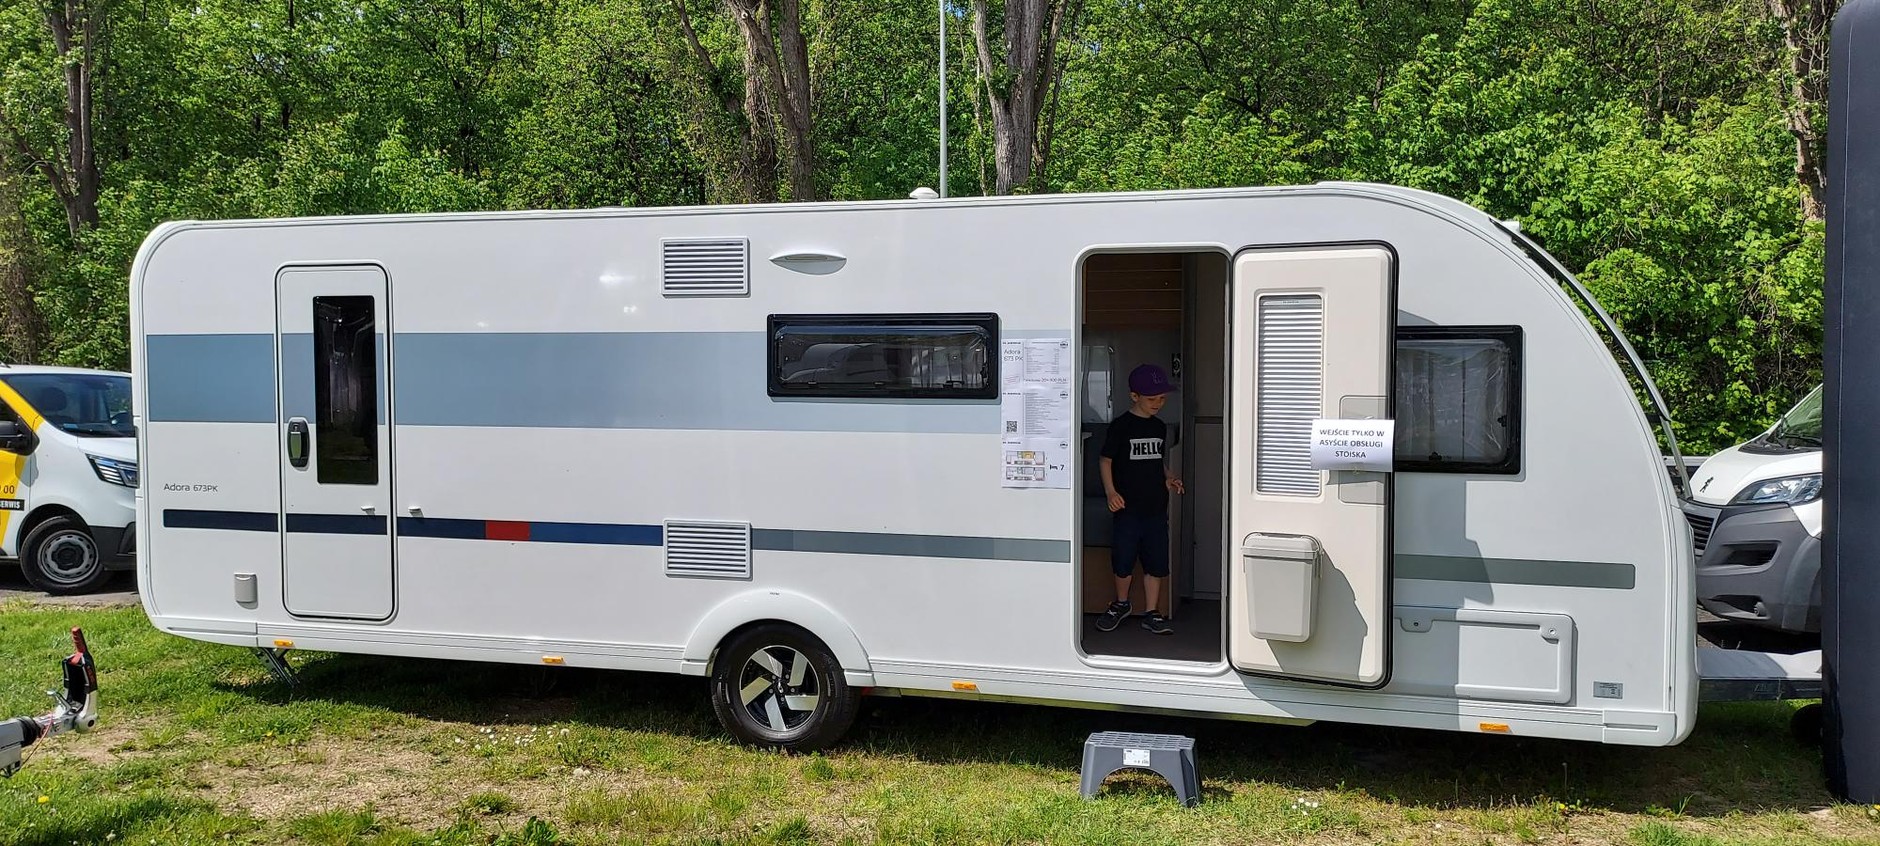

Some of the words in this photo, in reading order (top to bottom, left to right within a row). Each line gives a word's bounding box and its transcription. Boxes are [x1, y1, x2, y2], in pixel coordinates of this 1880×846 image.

[1319, 428, 1349, 436] WEJŚCIE
[1351, 429, 1375, 437] TYLKO
[1319, 439, 1348, 447] ASYŚCIE
[1350, 440, 1383, 448] OBSŁUGI
[1335, 450, 1366, 458] STOISKA
[163, 483, 190, 492] Adora
[193, 484, 218, 492] 673PK
